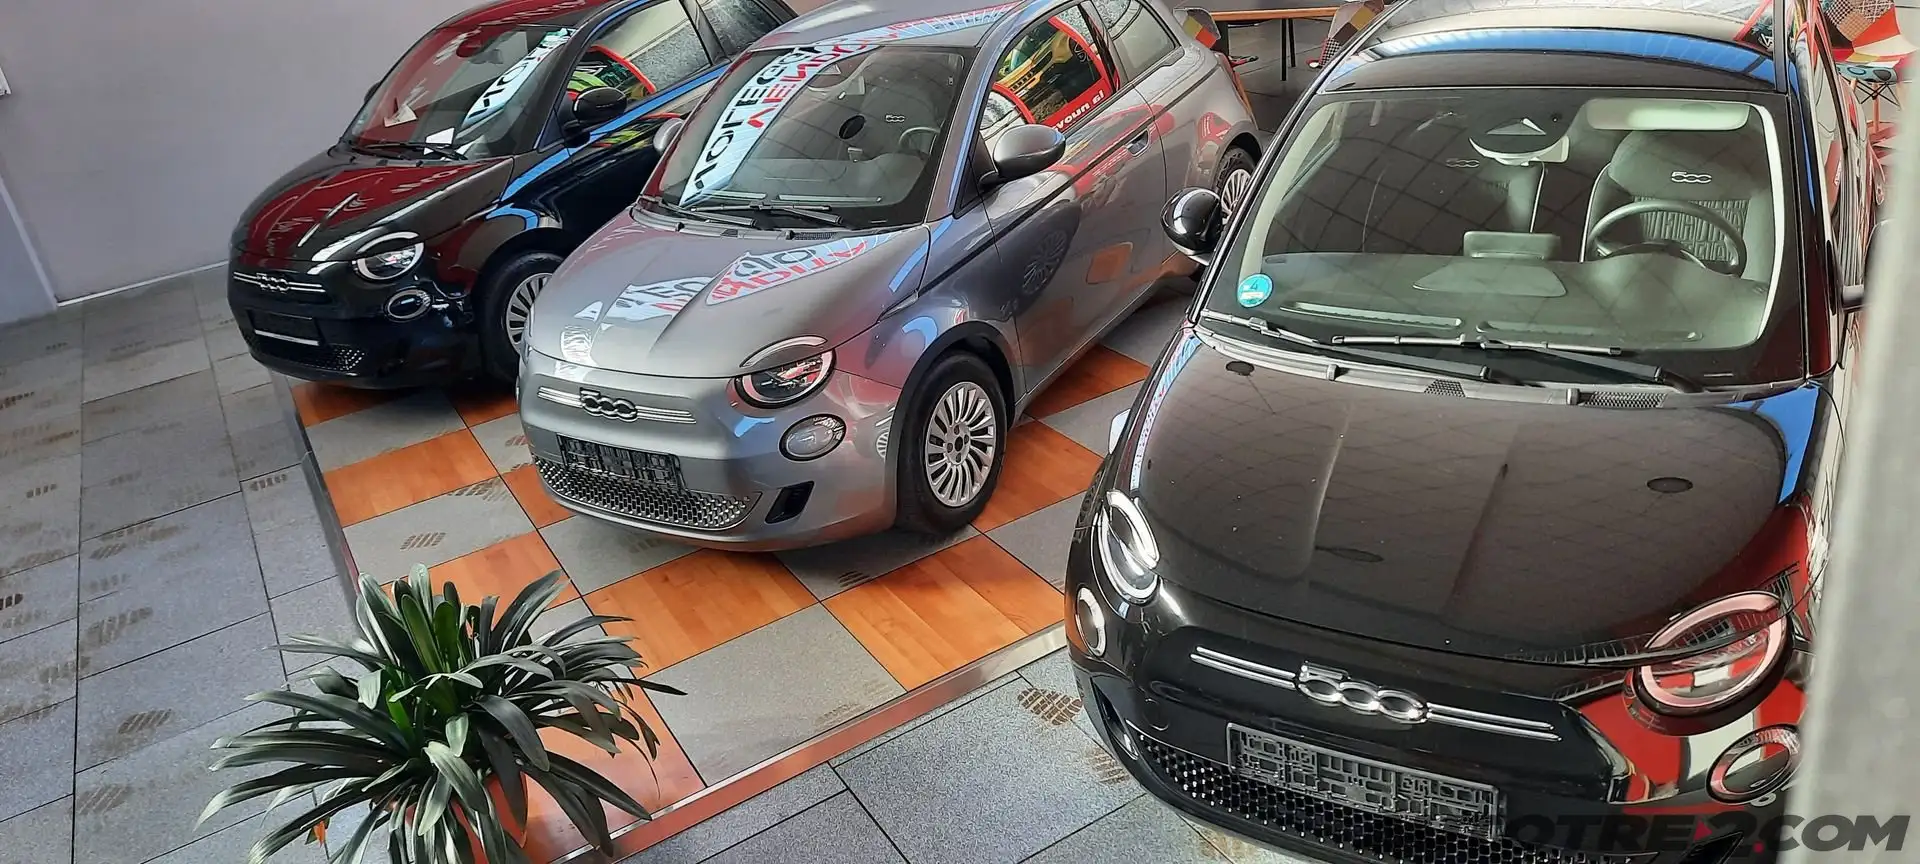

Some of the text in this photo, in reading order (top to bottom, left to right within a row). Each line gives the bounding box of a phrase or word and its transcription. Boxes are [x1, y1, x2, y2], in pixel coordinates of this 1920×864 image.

[1671, 171, 1712, 184] 500
[580, 388, 638, 421] 500
[1298, 661, 1427, 723] 500
